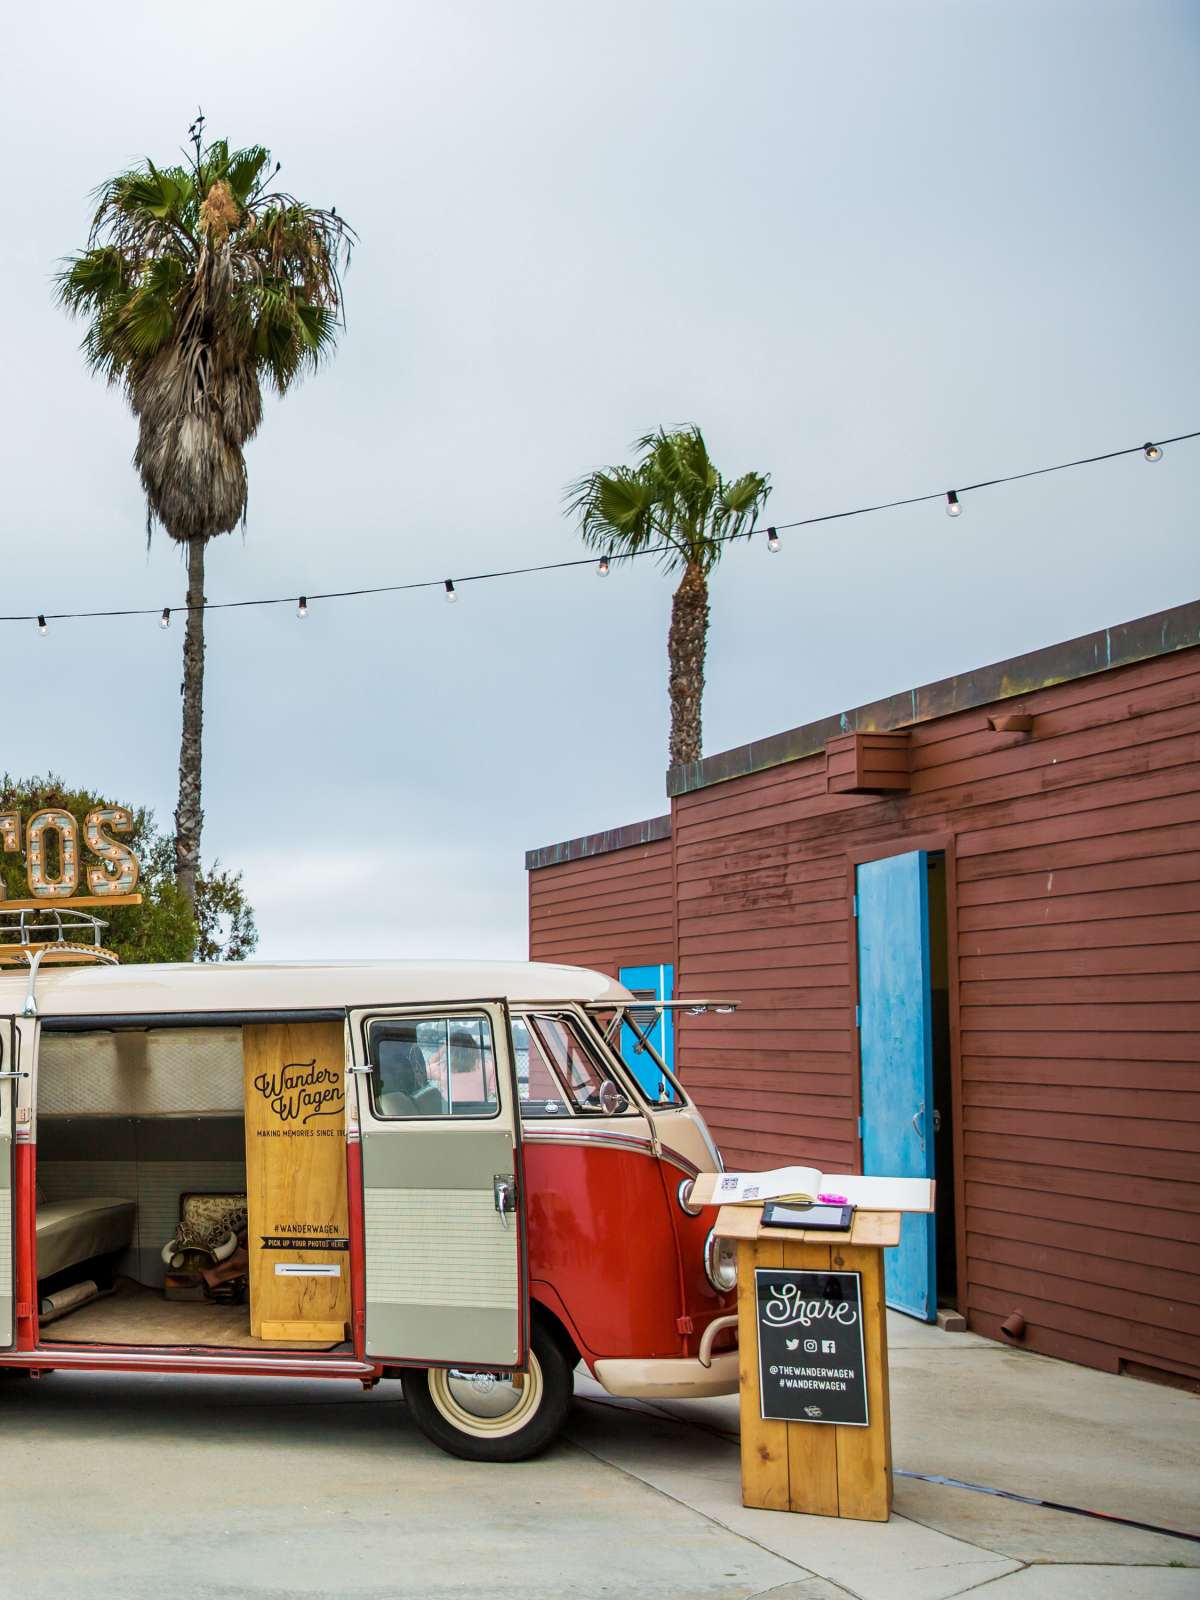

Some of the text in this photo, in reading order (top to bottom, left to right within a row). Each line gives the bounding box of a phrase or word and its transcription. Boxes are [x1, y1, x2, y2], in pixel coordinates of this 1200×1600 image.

[254, 1059, 339, 1098] Wander
[271, 1086, 345, 1124] Wagen
[256, 1129, 281, 1137] MAKING
[282, 1129, 314, 1137] MEMORIES
[316, 1129, 334, 1137] SINCE
[273, 1224, 339, 1234] #WANDERWAGEN
[267, 1239, 281, 1247] PICK
[282, 1239, 290, 1247] UP
[291, 1239, 306, 1248] YOUR
[307, 1240, 329, 1248] PHOTOS
[762, 1283, 857, 1327] Share
[769, 1365, 855, 1380] @THEWANDERWAGEN
[779, 1378, 847, 1392] #WANDERWAGEN
